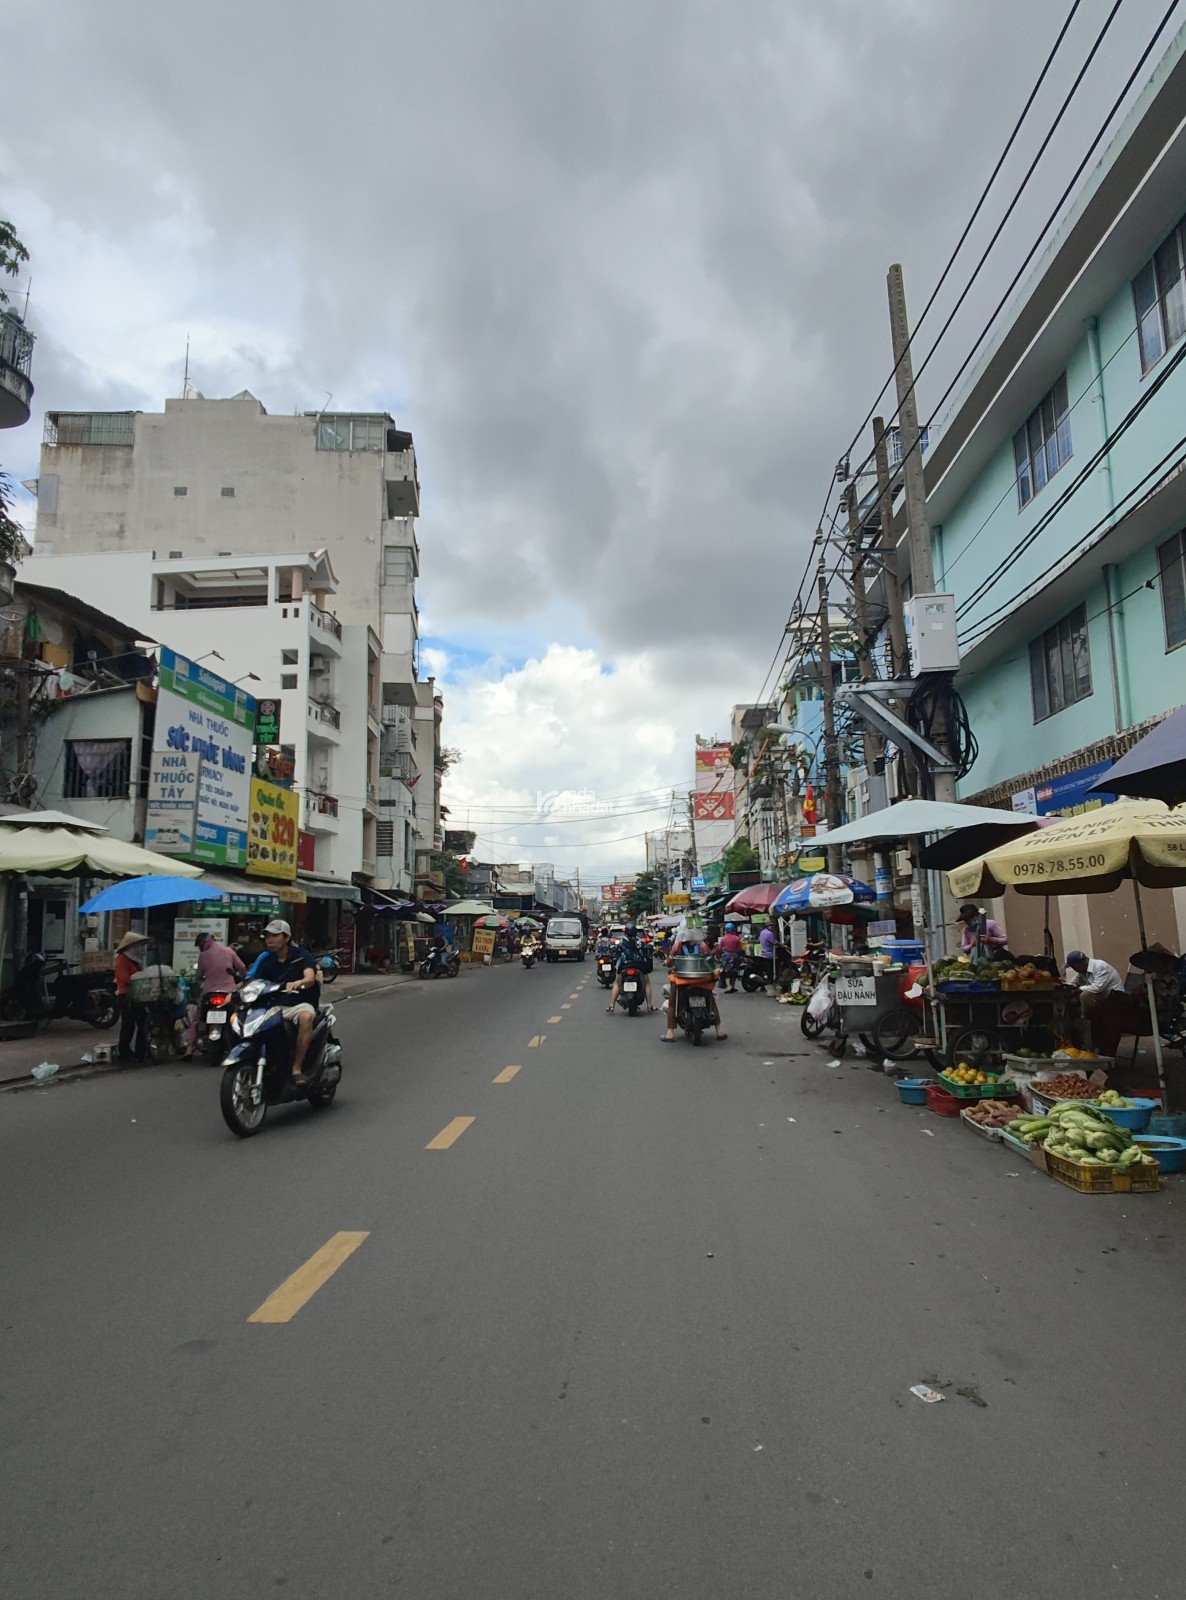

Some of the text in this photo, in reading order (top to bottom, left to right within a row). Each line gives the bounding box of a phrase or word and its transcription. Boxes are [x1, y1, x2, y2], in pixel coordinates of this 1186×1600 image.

[206, 717, 229, 737] THUỐC
[162, 754, 187, 767] NHÀ
[153, 768, 195, 783] THUỐC
[160, 785, 185, 799] TÂY
[272, 812, 296, 849] 329
[1013, 854, 1106, 877] 0978.78.55.00
